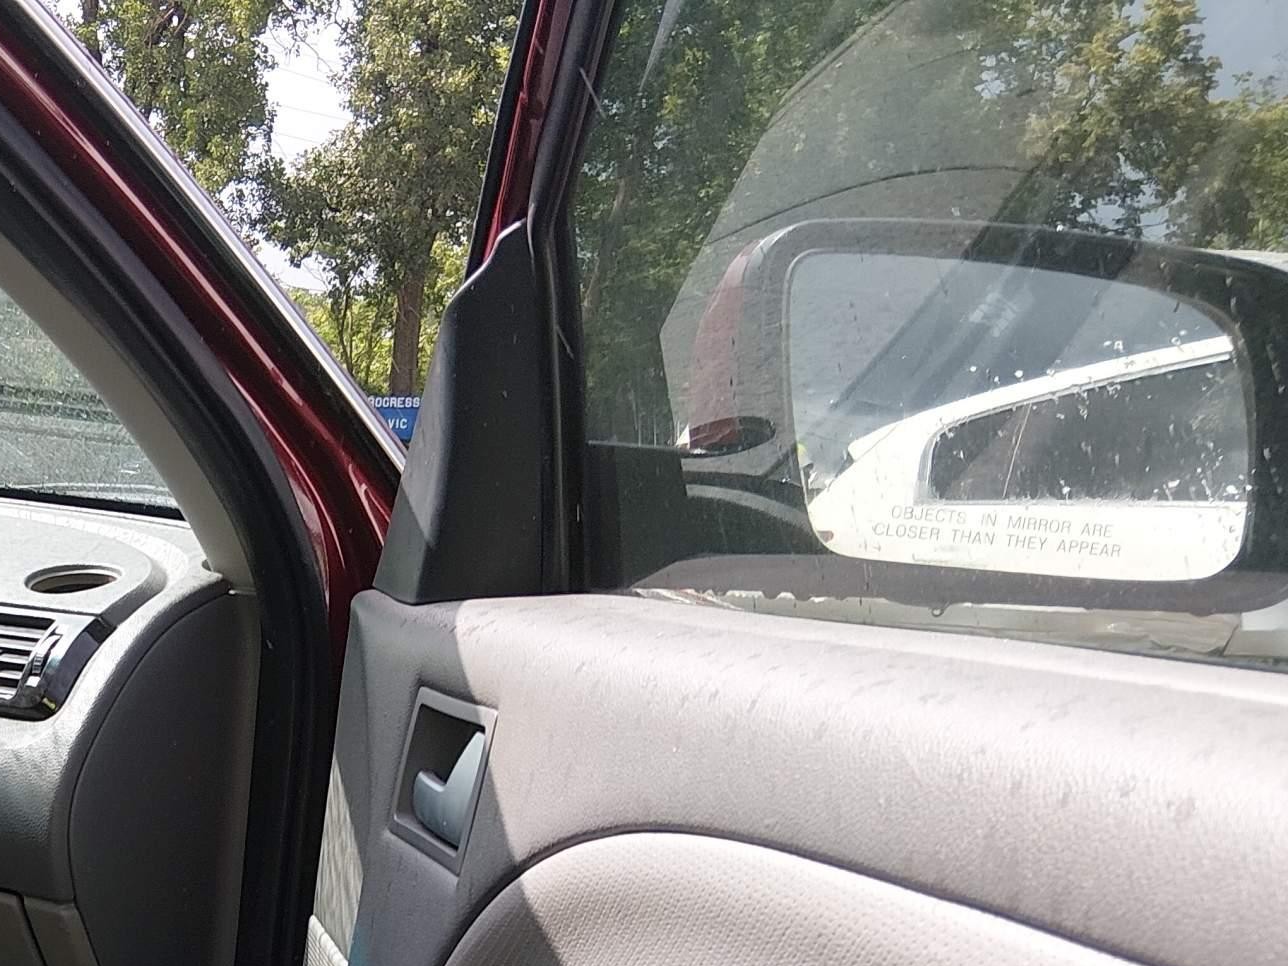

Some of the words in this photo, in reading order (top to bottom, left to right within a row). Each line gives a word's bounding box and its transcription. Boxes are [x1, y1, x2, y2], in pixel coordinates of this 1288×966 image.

[890, 504, 967, 525] OBJECTS
[980, 512, 997, 527] IN
[1006, 516, 1072, 535] MIRROR
[1080, 522, 1114, 538] ARE
[873, 523, 941, 541] CLOSER
[951, 529, 995, 546] THAN
[1005, 534, 1048, 551] THEY
[1055, 539, 1122, 558] APPEAR
